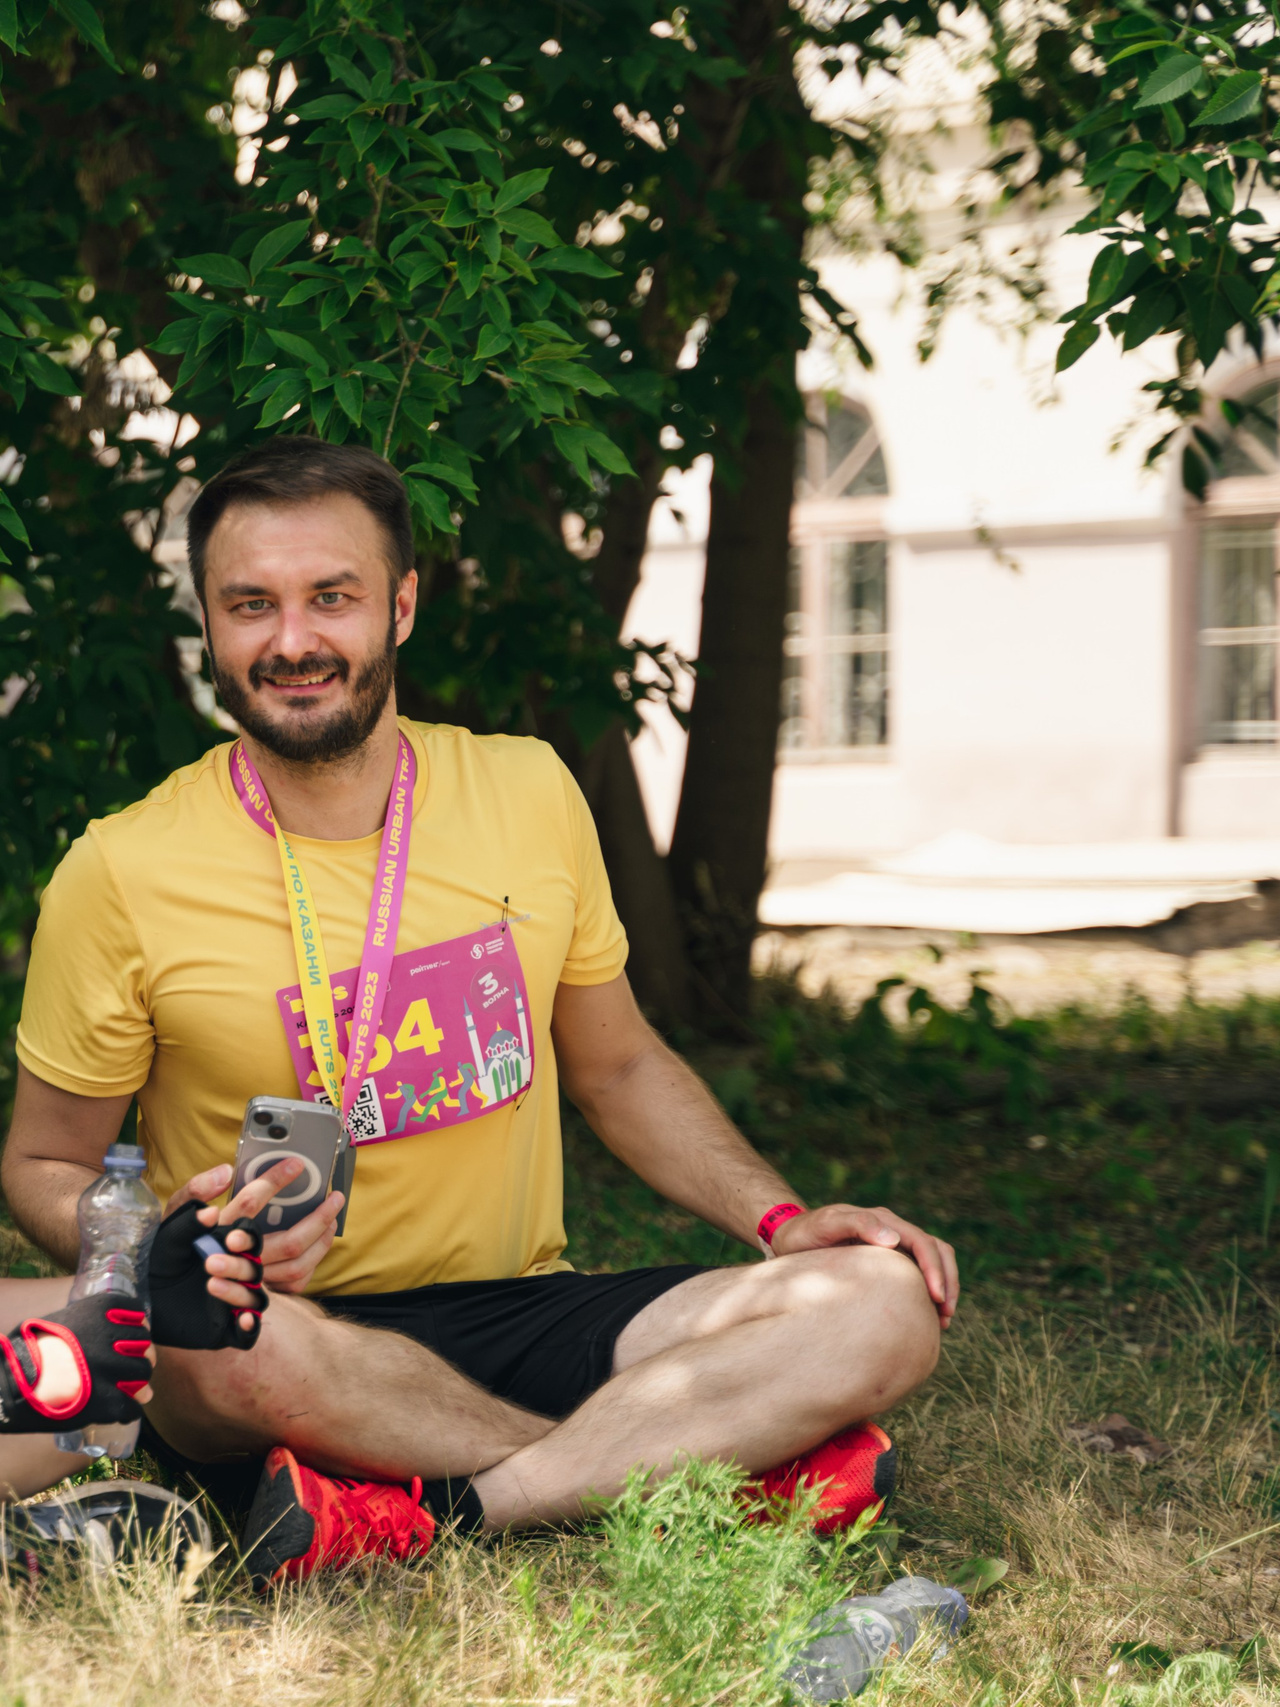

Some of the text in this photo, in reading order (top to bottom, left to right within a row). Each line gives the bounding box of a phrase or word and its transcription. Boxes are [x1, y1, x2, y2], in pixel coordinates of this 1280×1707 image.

[289, 865, 304, 894] ПО
[372, 859, 398, 948] RUSSIAN
[388, 787, 407, 856] URBAN
[296, 899, 322, 985] КАЗАНИ
[477, 971, 499, 996] 3
[481, 986, 510, 1009] ВОЛНА
[316, 1018, 335, 1074] RUTS
[350, 971, 380, 1079] RUTS 2023
